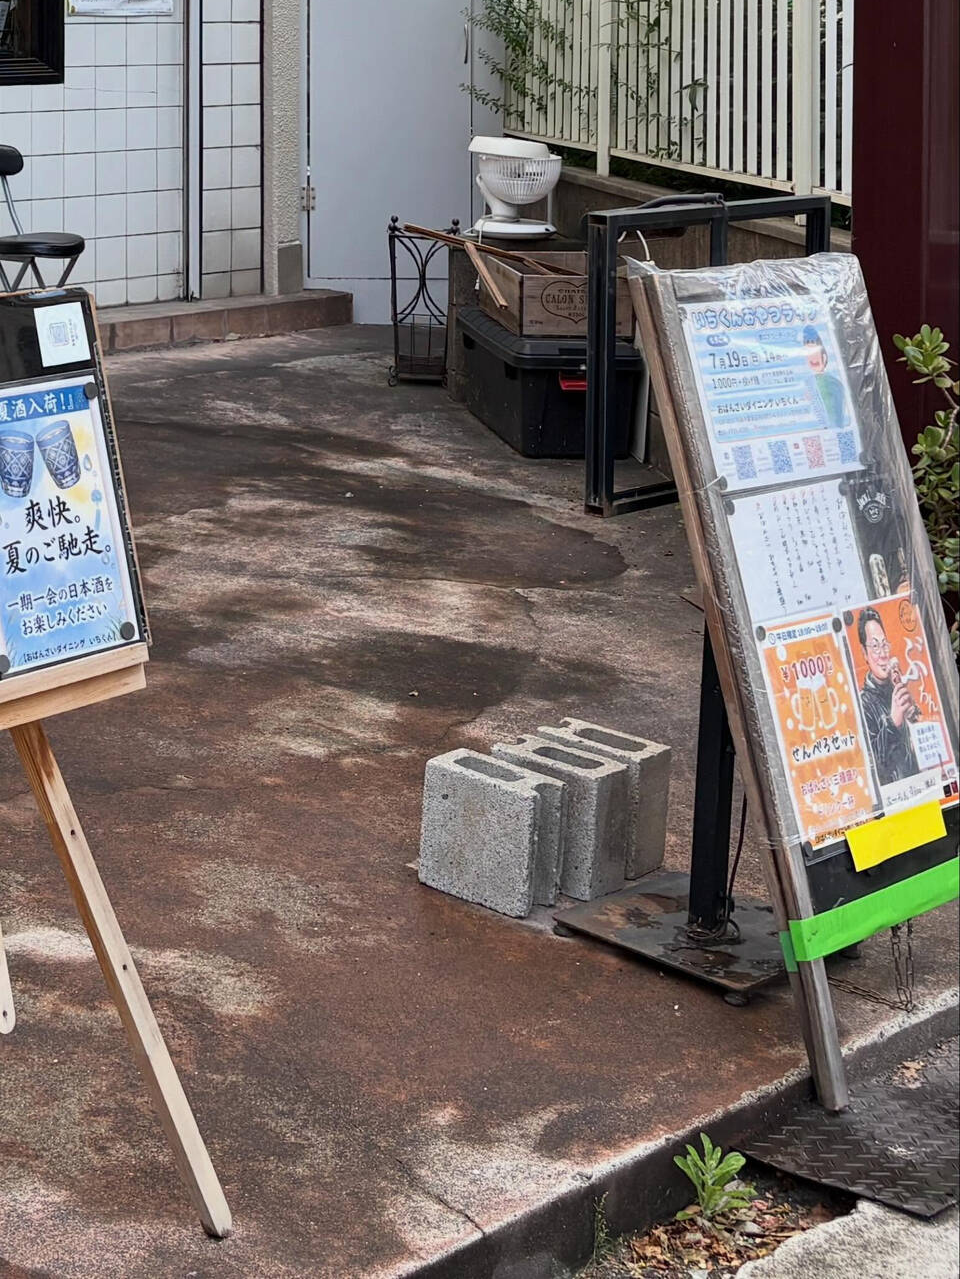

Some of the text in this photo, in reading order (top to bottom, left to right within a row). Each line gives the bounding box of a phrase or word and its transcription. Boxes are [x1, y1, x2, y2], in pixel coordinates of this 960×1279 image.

[545, 294, 574, 304] CALON
[25, 495, 81, 534] 爽快。
[2, 525, 111, 576] 夏のご馳走。
[7, 575, 113, 612] 一期一会の日本酒を
[21, 603, 108, 636] お楽しみください
[792, 730, 856, 762] せんべろセット
